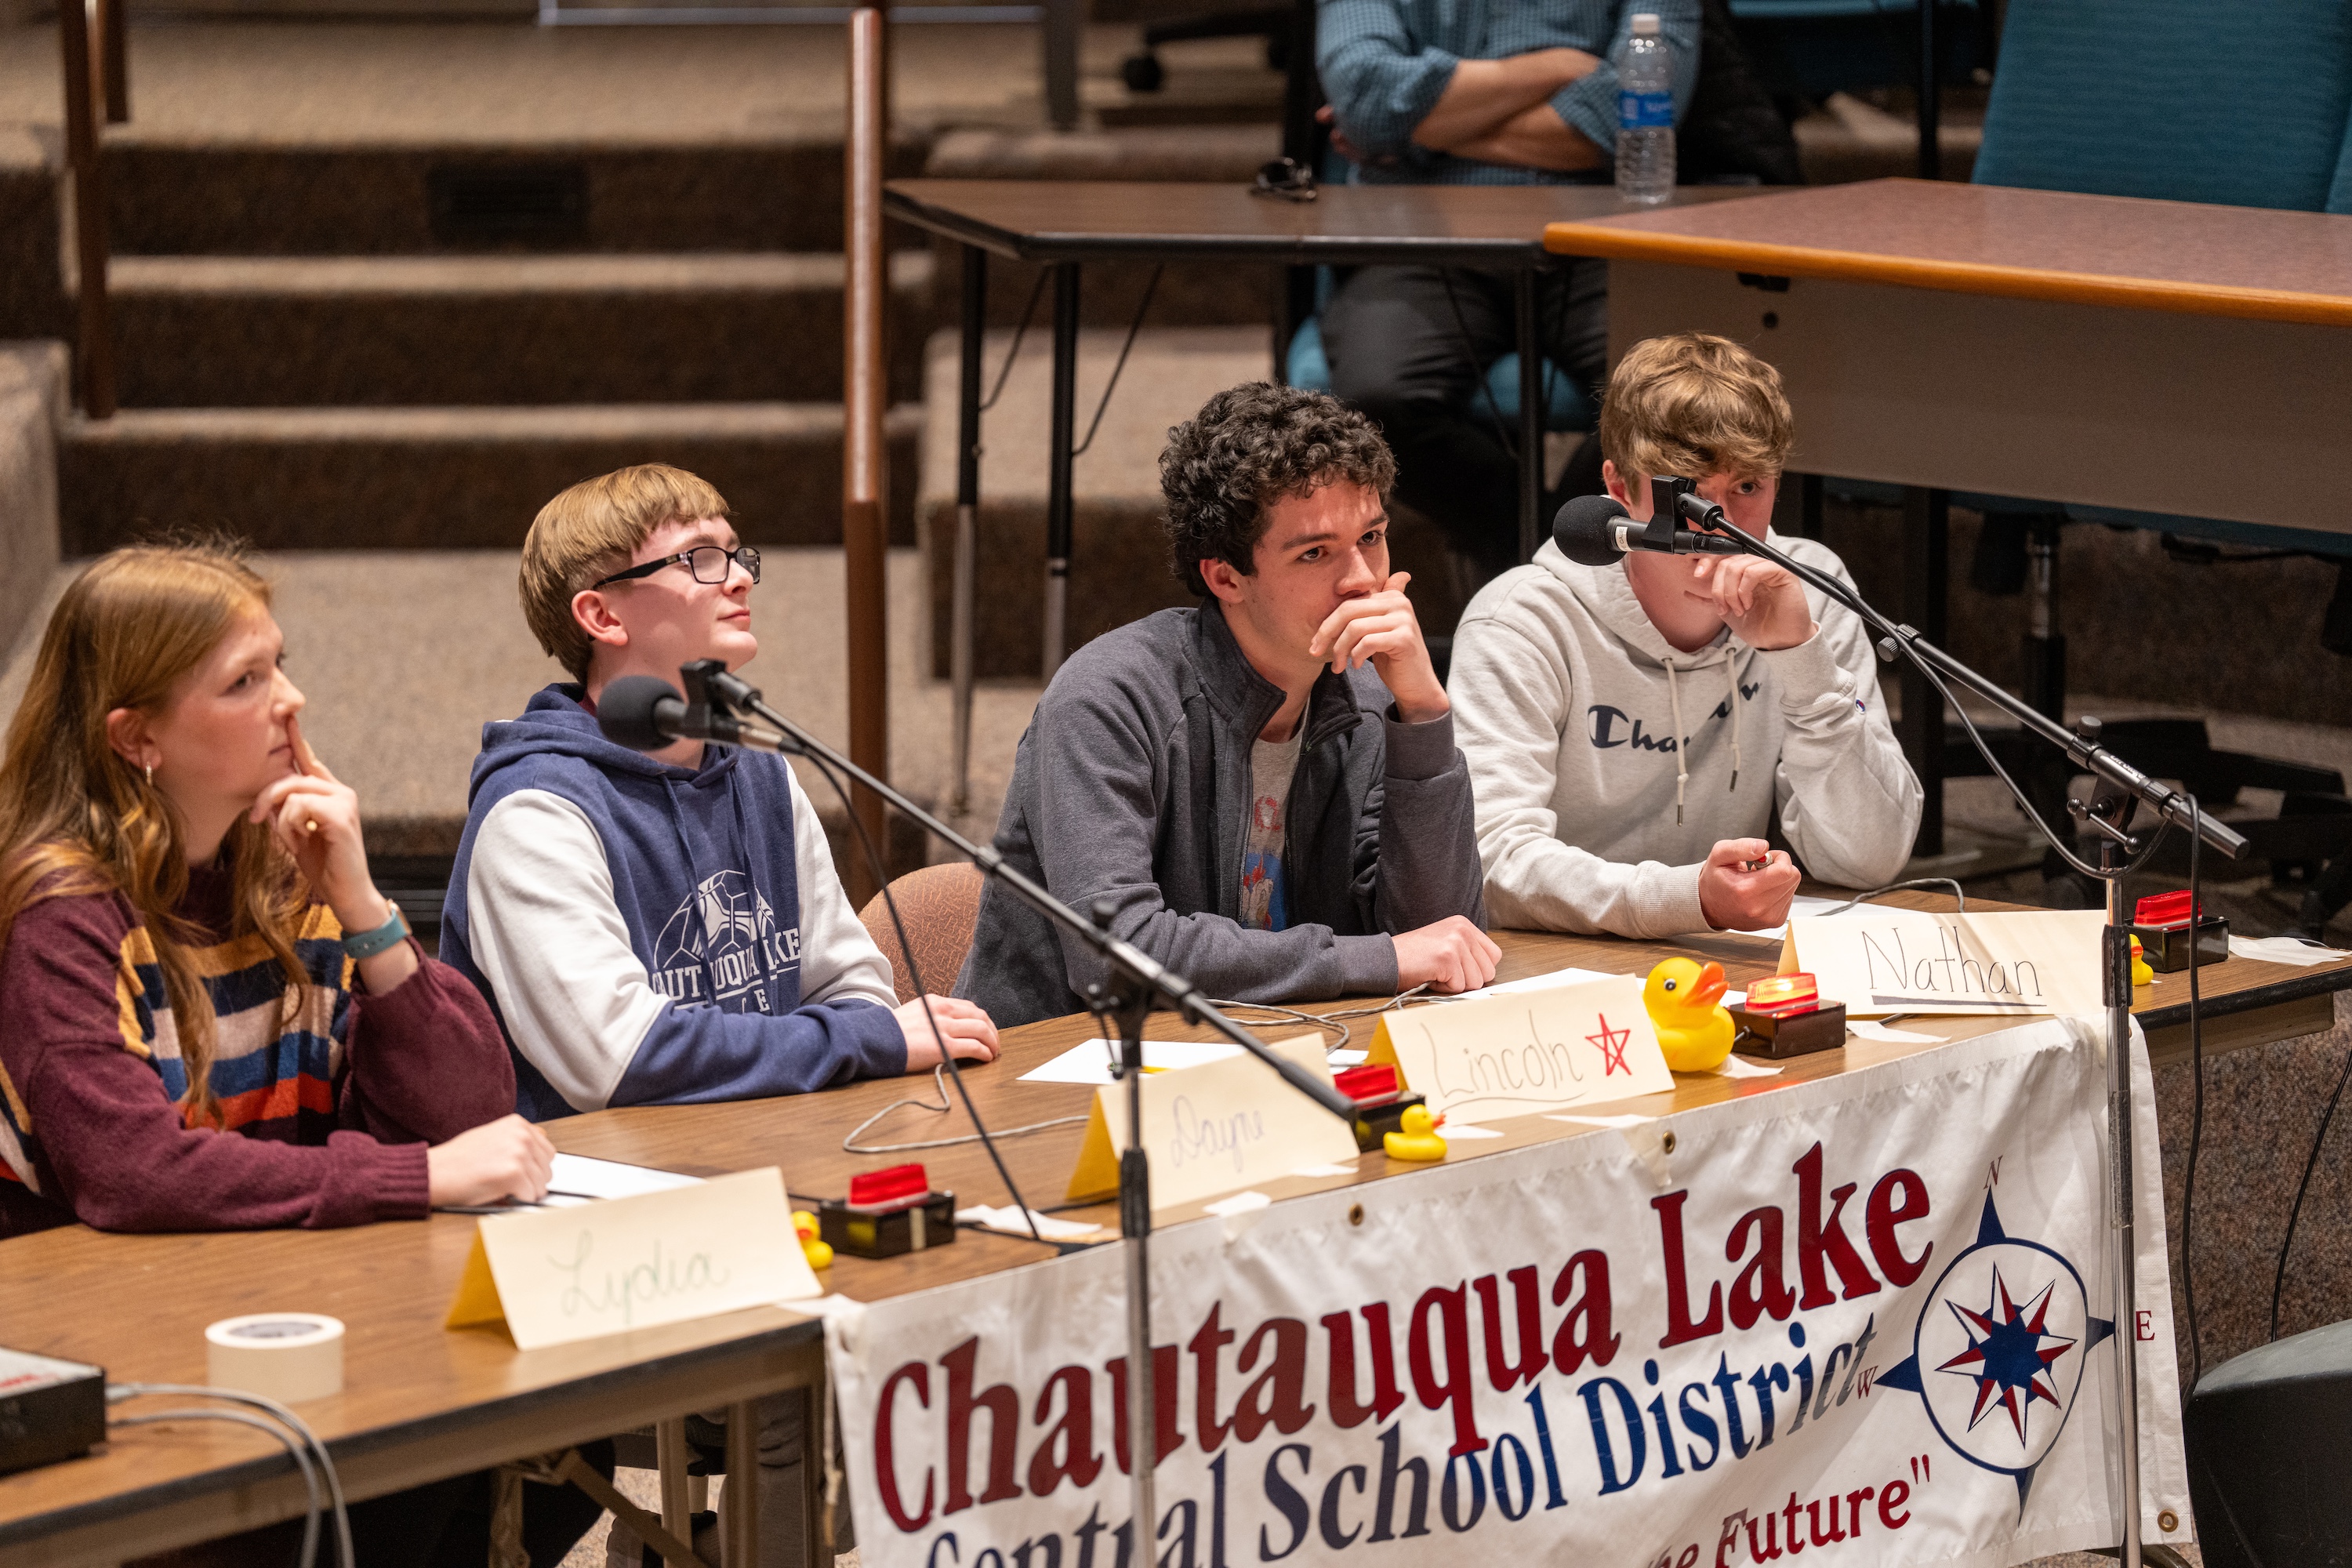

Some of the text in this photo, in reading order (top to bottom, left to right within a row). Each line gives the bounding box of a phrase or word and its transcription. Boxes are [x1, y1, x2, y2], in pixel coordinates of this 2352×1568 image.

[762, 927, 801, 971] LKE
[1861, 925, 2043, 996] Nathan
[1420, 1009, 1584, 1098] Lincoln
[1984, 1155, 2003, 1189] N
[548, 1229, 731, 1326] Lydia
[874, 1248, 1621, 1533] Chautauqua
[1650, 1140, 1934, 1348] Lake
[2136, 1310, 2155, 1341] E
[1857, 1365, 1878, 1399] W
[1259, 1381, 1569, 1562] School
[1577, 1312, 1878, 1497] District
[1714, 1453, 1930, 1568] Future"
